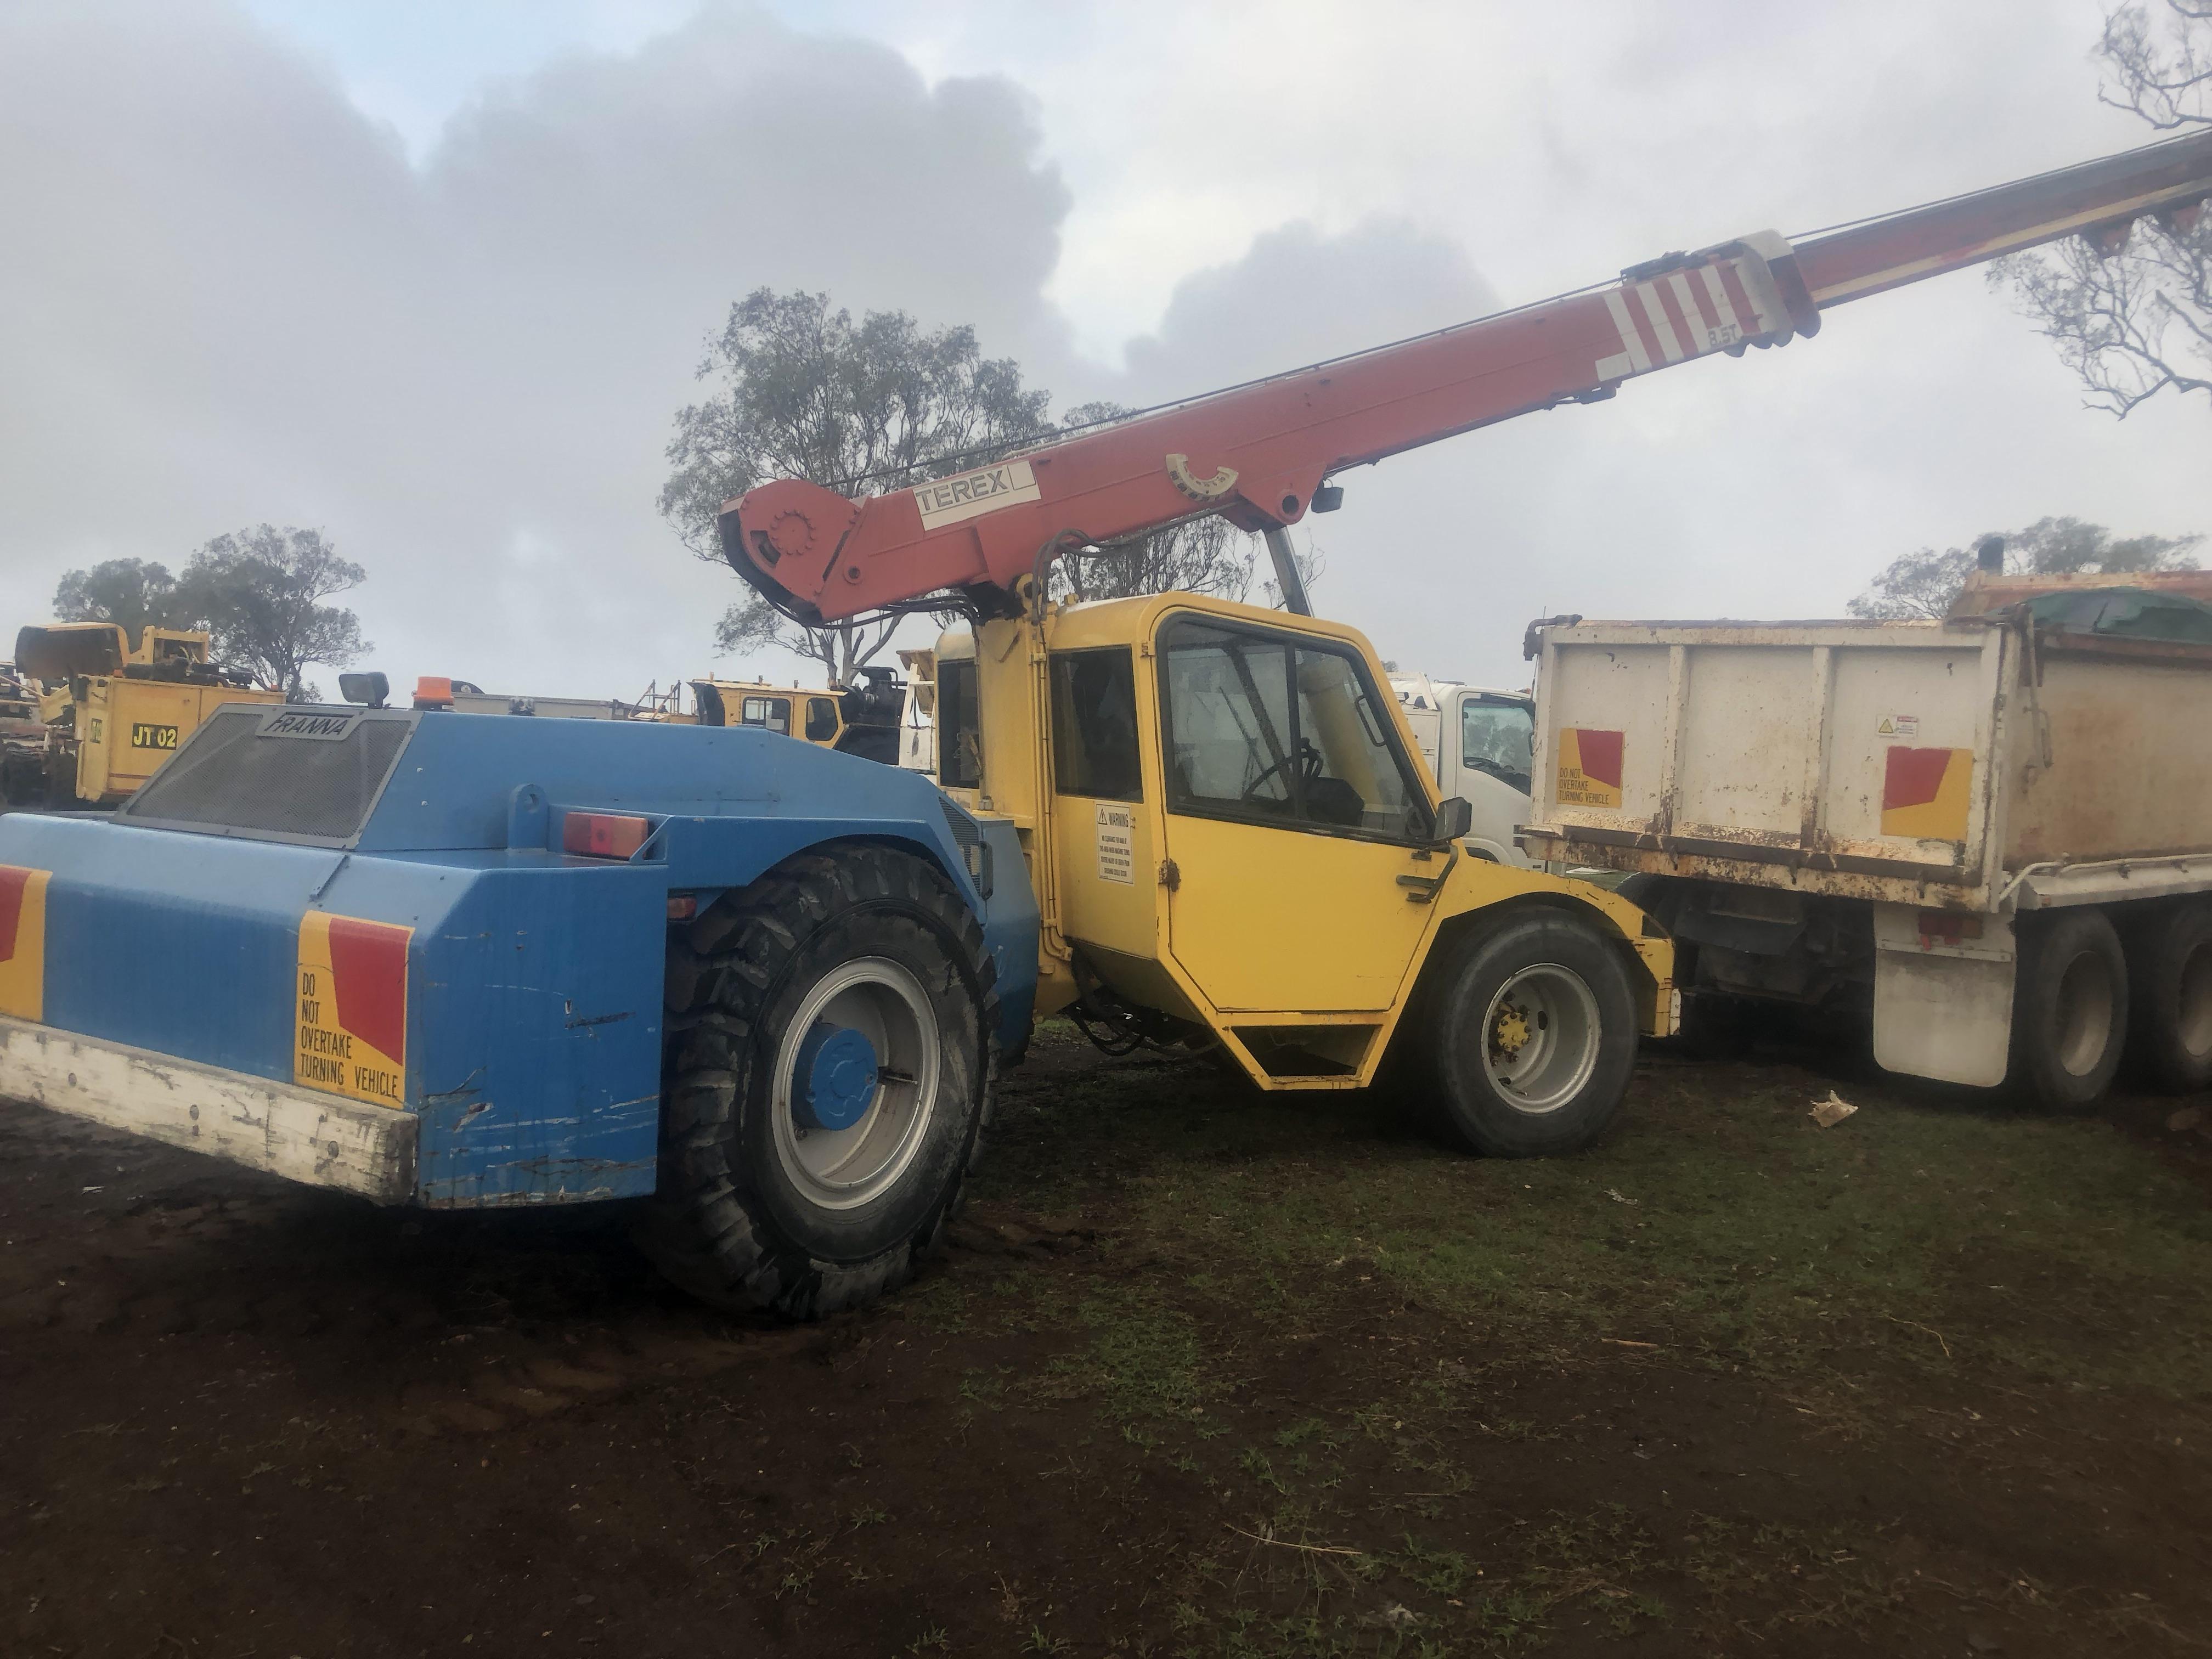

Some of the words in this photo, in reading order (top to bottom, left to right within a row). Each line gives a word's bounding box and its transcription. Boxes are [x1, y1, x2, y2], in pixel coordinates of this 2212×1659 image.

[916, 470, 1007, 511] TEREX
[264, 714, 348, 735] FRANNA
[133, 726, 155, 746] JT
[157, 728, 177, 747] 02
[1560, 768, 1567, 778] DO
[1570, 769, 1581, 778] NOT
[1559, 780, 1588, 791] OVERTAKE
[1559, 790, 1583, 802] TURNING
[1585, 793, 1609, 805] VEHICLE
[1109, 812, 1128, 827] WARNING
[302, 972, 315, 997] DO
[302, 999, 320, 1024] NOT
[301, 1025, 352, 1059] OVERTAKE
[301, 1053, 345, 1086] TURNING
[354, 1065, 398, 1097] VEHICLE
